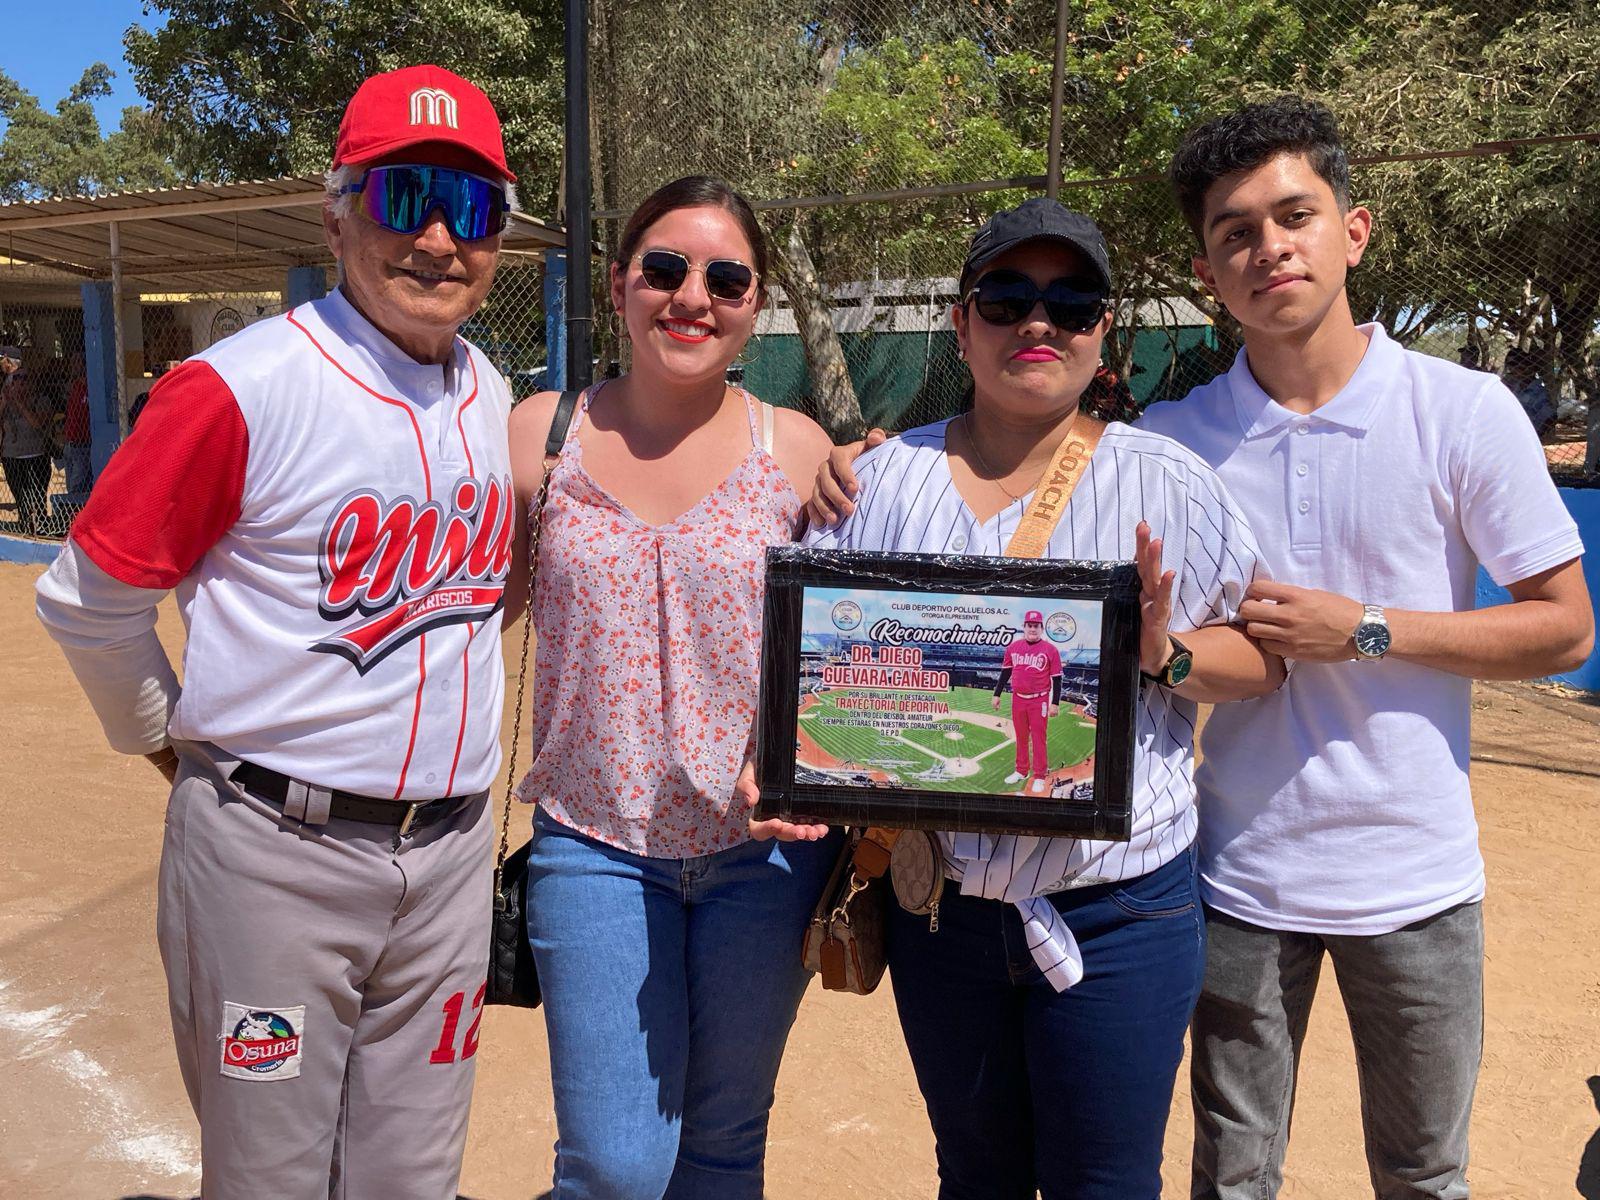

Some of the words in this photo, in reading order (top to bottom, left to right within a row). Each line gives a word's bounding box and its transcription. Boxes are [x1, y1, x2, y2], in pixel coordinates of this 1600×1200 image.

[1033, 441, 1085, 520] COACH
[319, 474, 514, 612] Mill
[891, 603, 911, 611] CLUB
[912, 604, 953, 613] DEPORTIVO
[954, 606, 996, 615] POLLUELOS
[869, 617, 1017, 647] Reconocimiento
[840, 650, 850, 662] A:
[852, 646, 875, 663] DR.
[880, 647, 921, 665] DIEGO
[824, 667, 888, 686] GUEVARA
[891, 668, 949, 689] CAÑEDO
[835, 697, 896, 711] TRAYECTORIA
[899, 701, 949, 714] DEPORTIVA
[848, 691, 860, 699] POR
[869, 692, 898, 700] BRILLANTE
[904, 693, 936, 702] DESTACADA
[822, 718, 847, 727] SIEMPRE
[847, 719, 872, 728] ESTARAS
[872, 720, 880, 728] EN
[880, 720, 910, 729] NUESTROS
[910, 722, 942, 731] CORAZONES
[943, 723, 960, 731] DIEGO
[850, 711, 871, 719] DENTRO
[872, 711, 883, 719] DEL
[884, 712, 906, 720] BEISBOL
[908, 713, 933, 721] AMATEUR
[228, 1039, 297, 1062] Osuna
